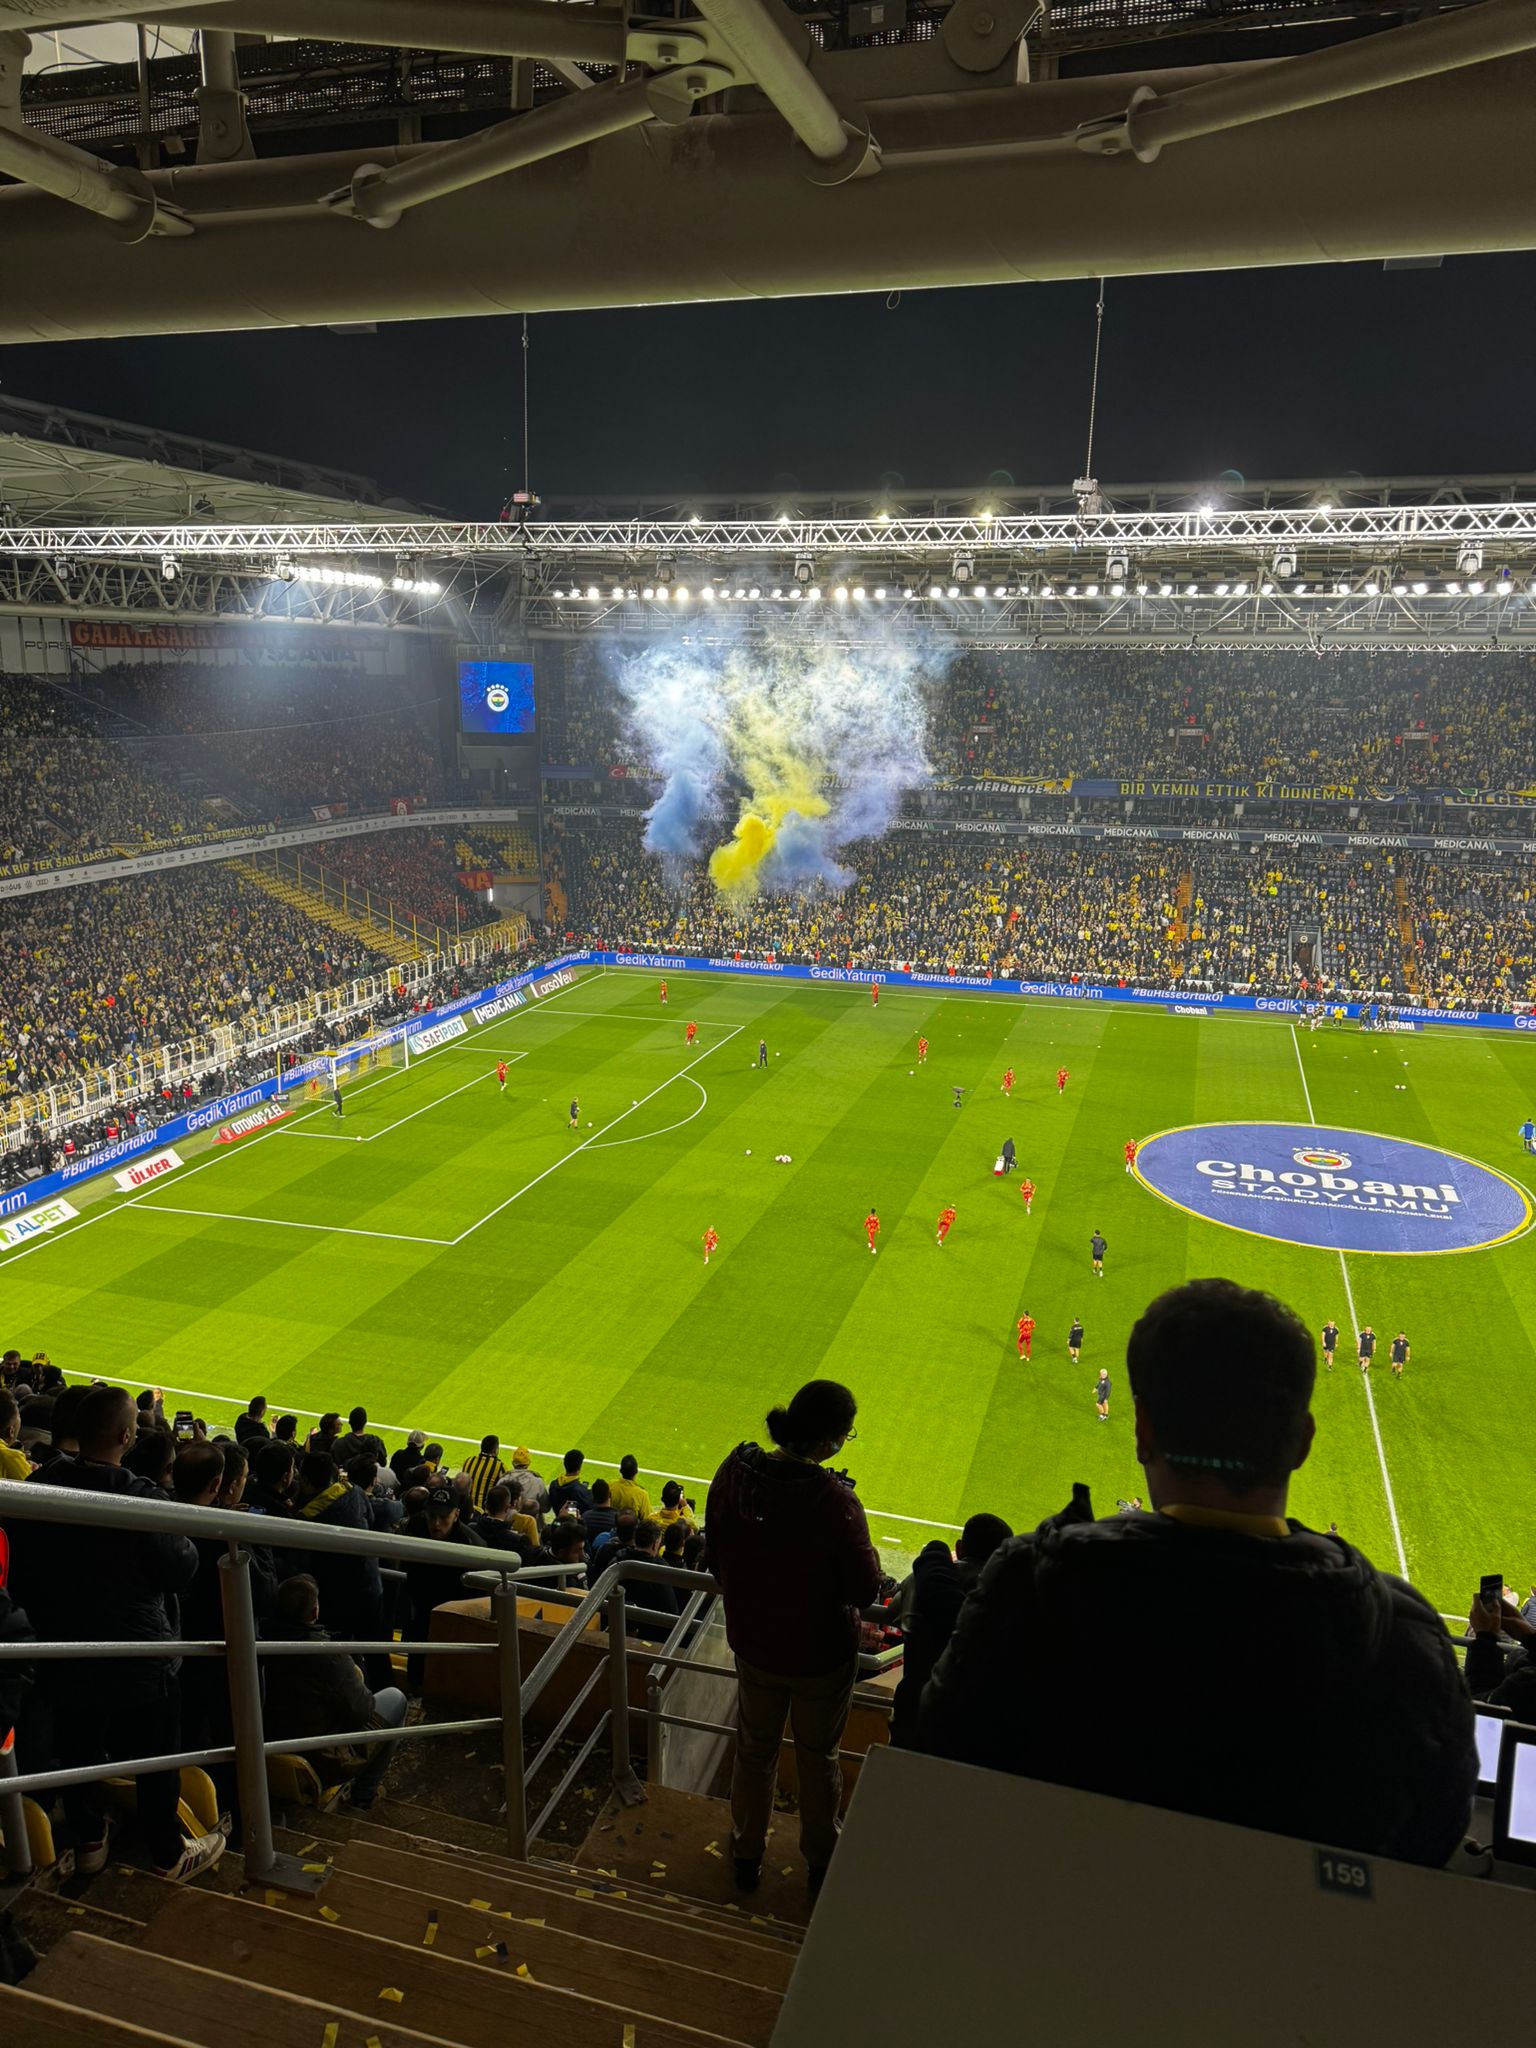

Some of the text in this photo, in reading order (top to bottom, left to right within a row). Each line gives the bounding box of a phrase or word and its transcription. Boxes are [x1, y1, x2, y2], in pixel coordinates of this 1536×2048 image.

[553, 807, 596, 816] MEDICANA
[620, 808, 644, 817] MEDIC
[955, 823, 1001, 832] MEDICANA
[1028, 825, 1075, 834] MEDICANA
[1104, 827, 1152, 838] MEDICANA
[1182, 830, 1234, 841] MEDICANA
[1264, 833, 1317, 844] MEDICANA
[1348, 836, 1402, 847] MEDICANA
[1434, 839, 1490, 850] MEDICANA
[33, 858, 53, 872] TEK
[55, 854, 81, 868] SANA
[477, 992, 522, 1022] MEDICANA
[1174, 1004, 1208, 1015] Chobani
[62, 1129, 158, 1181] #BuHisseOrtakOl
[128, 1158, 173, 1186] ÜLKER
[1196, 1159, 1462, 1203] Chobani
[1210, 1179, 1450, 1214] STADYUMU
[15, 1204, 67, 1236] ALPET
[1322, 1860, 1366, 1888] 159
